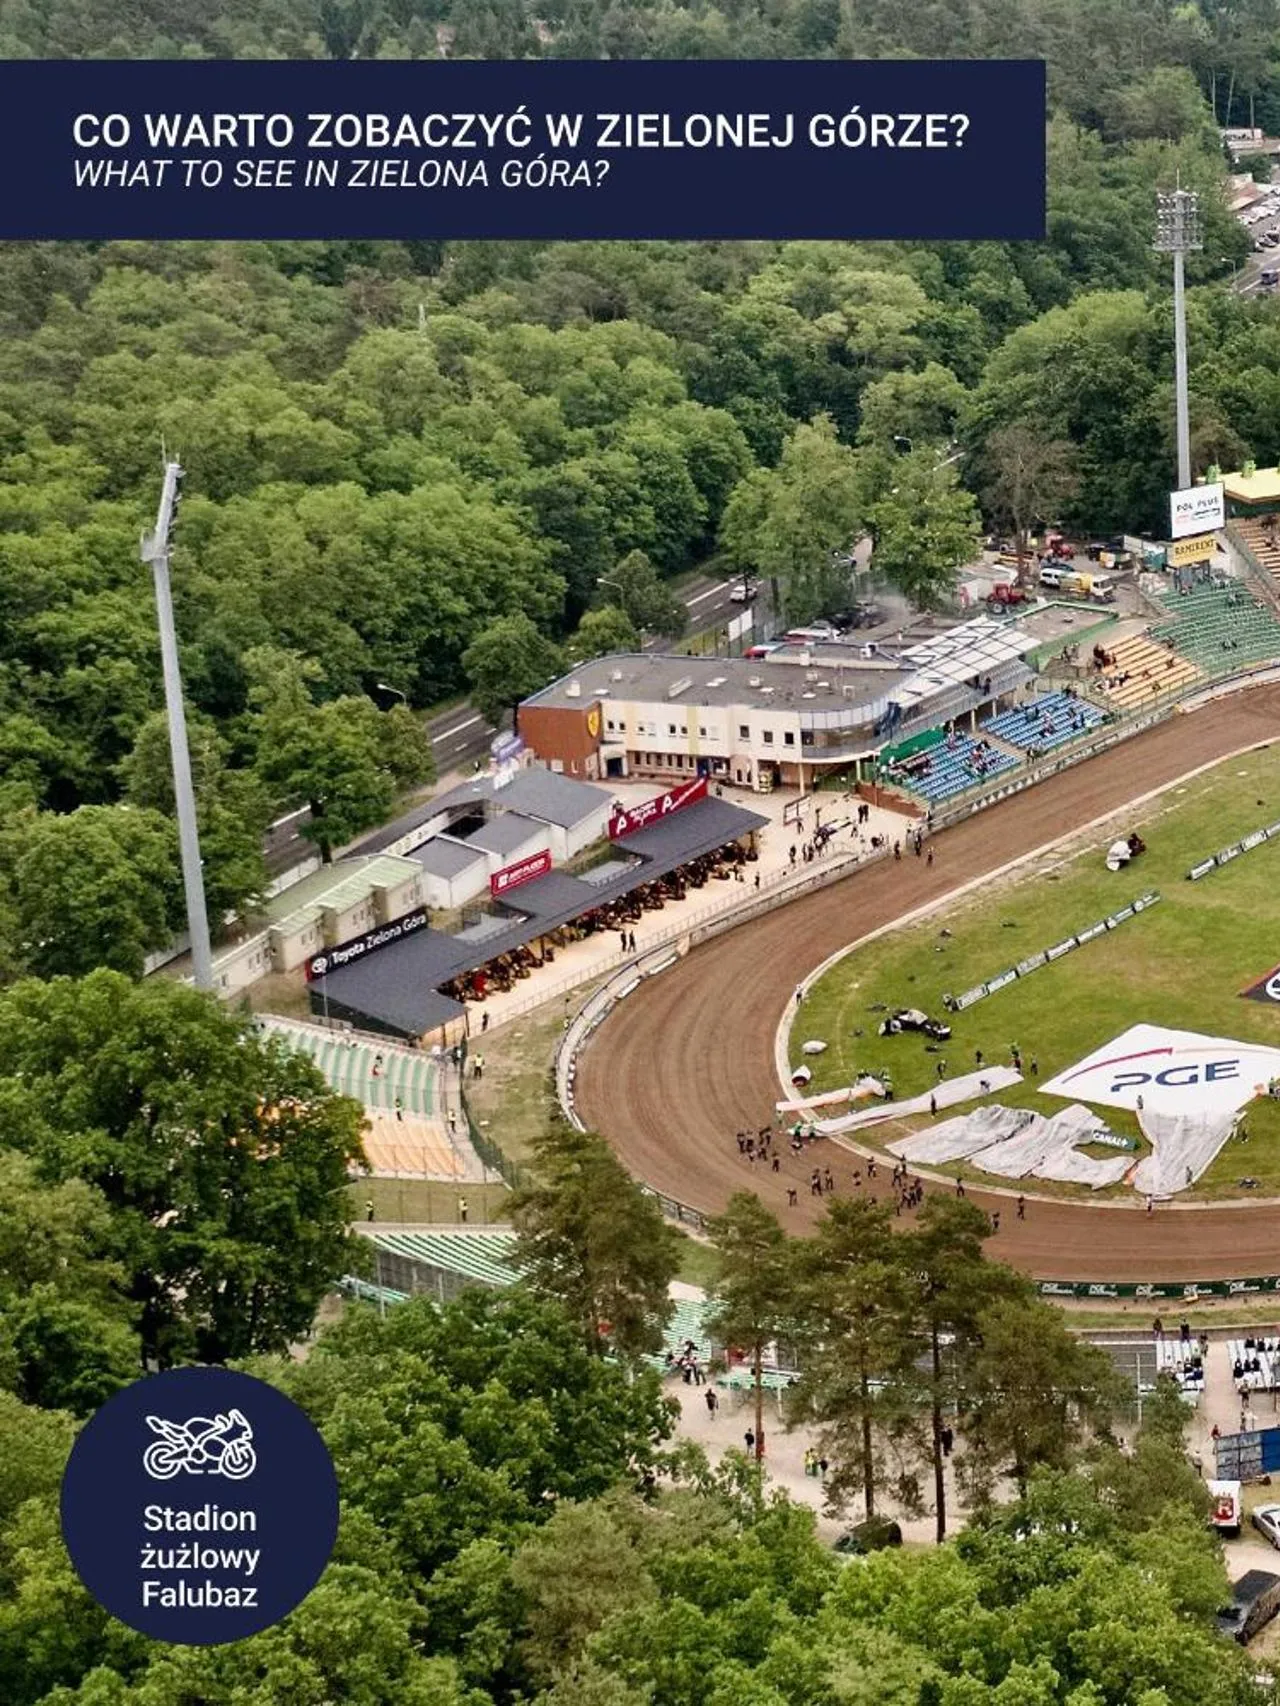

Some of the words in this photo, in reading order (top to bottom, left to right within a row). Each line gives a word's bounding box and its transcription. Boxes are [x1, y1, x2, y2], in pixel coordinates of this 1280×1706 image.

[332, 942, 365, 964] Toyota
[366, 925, 402, 949] Zielona
[402, 914, 427, 931] Góra
[1110, 1059, 1240, 1093] PGE
